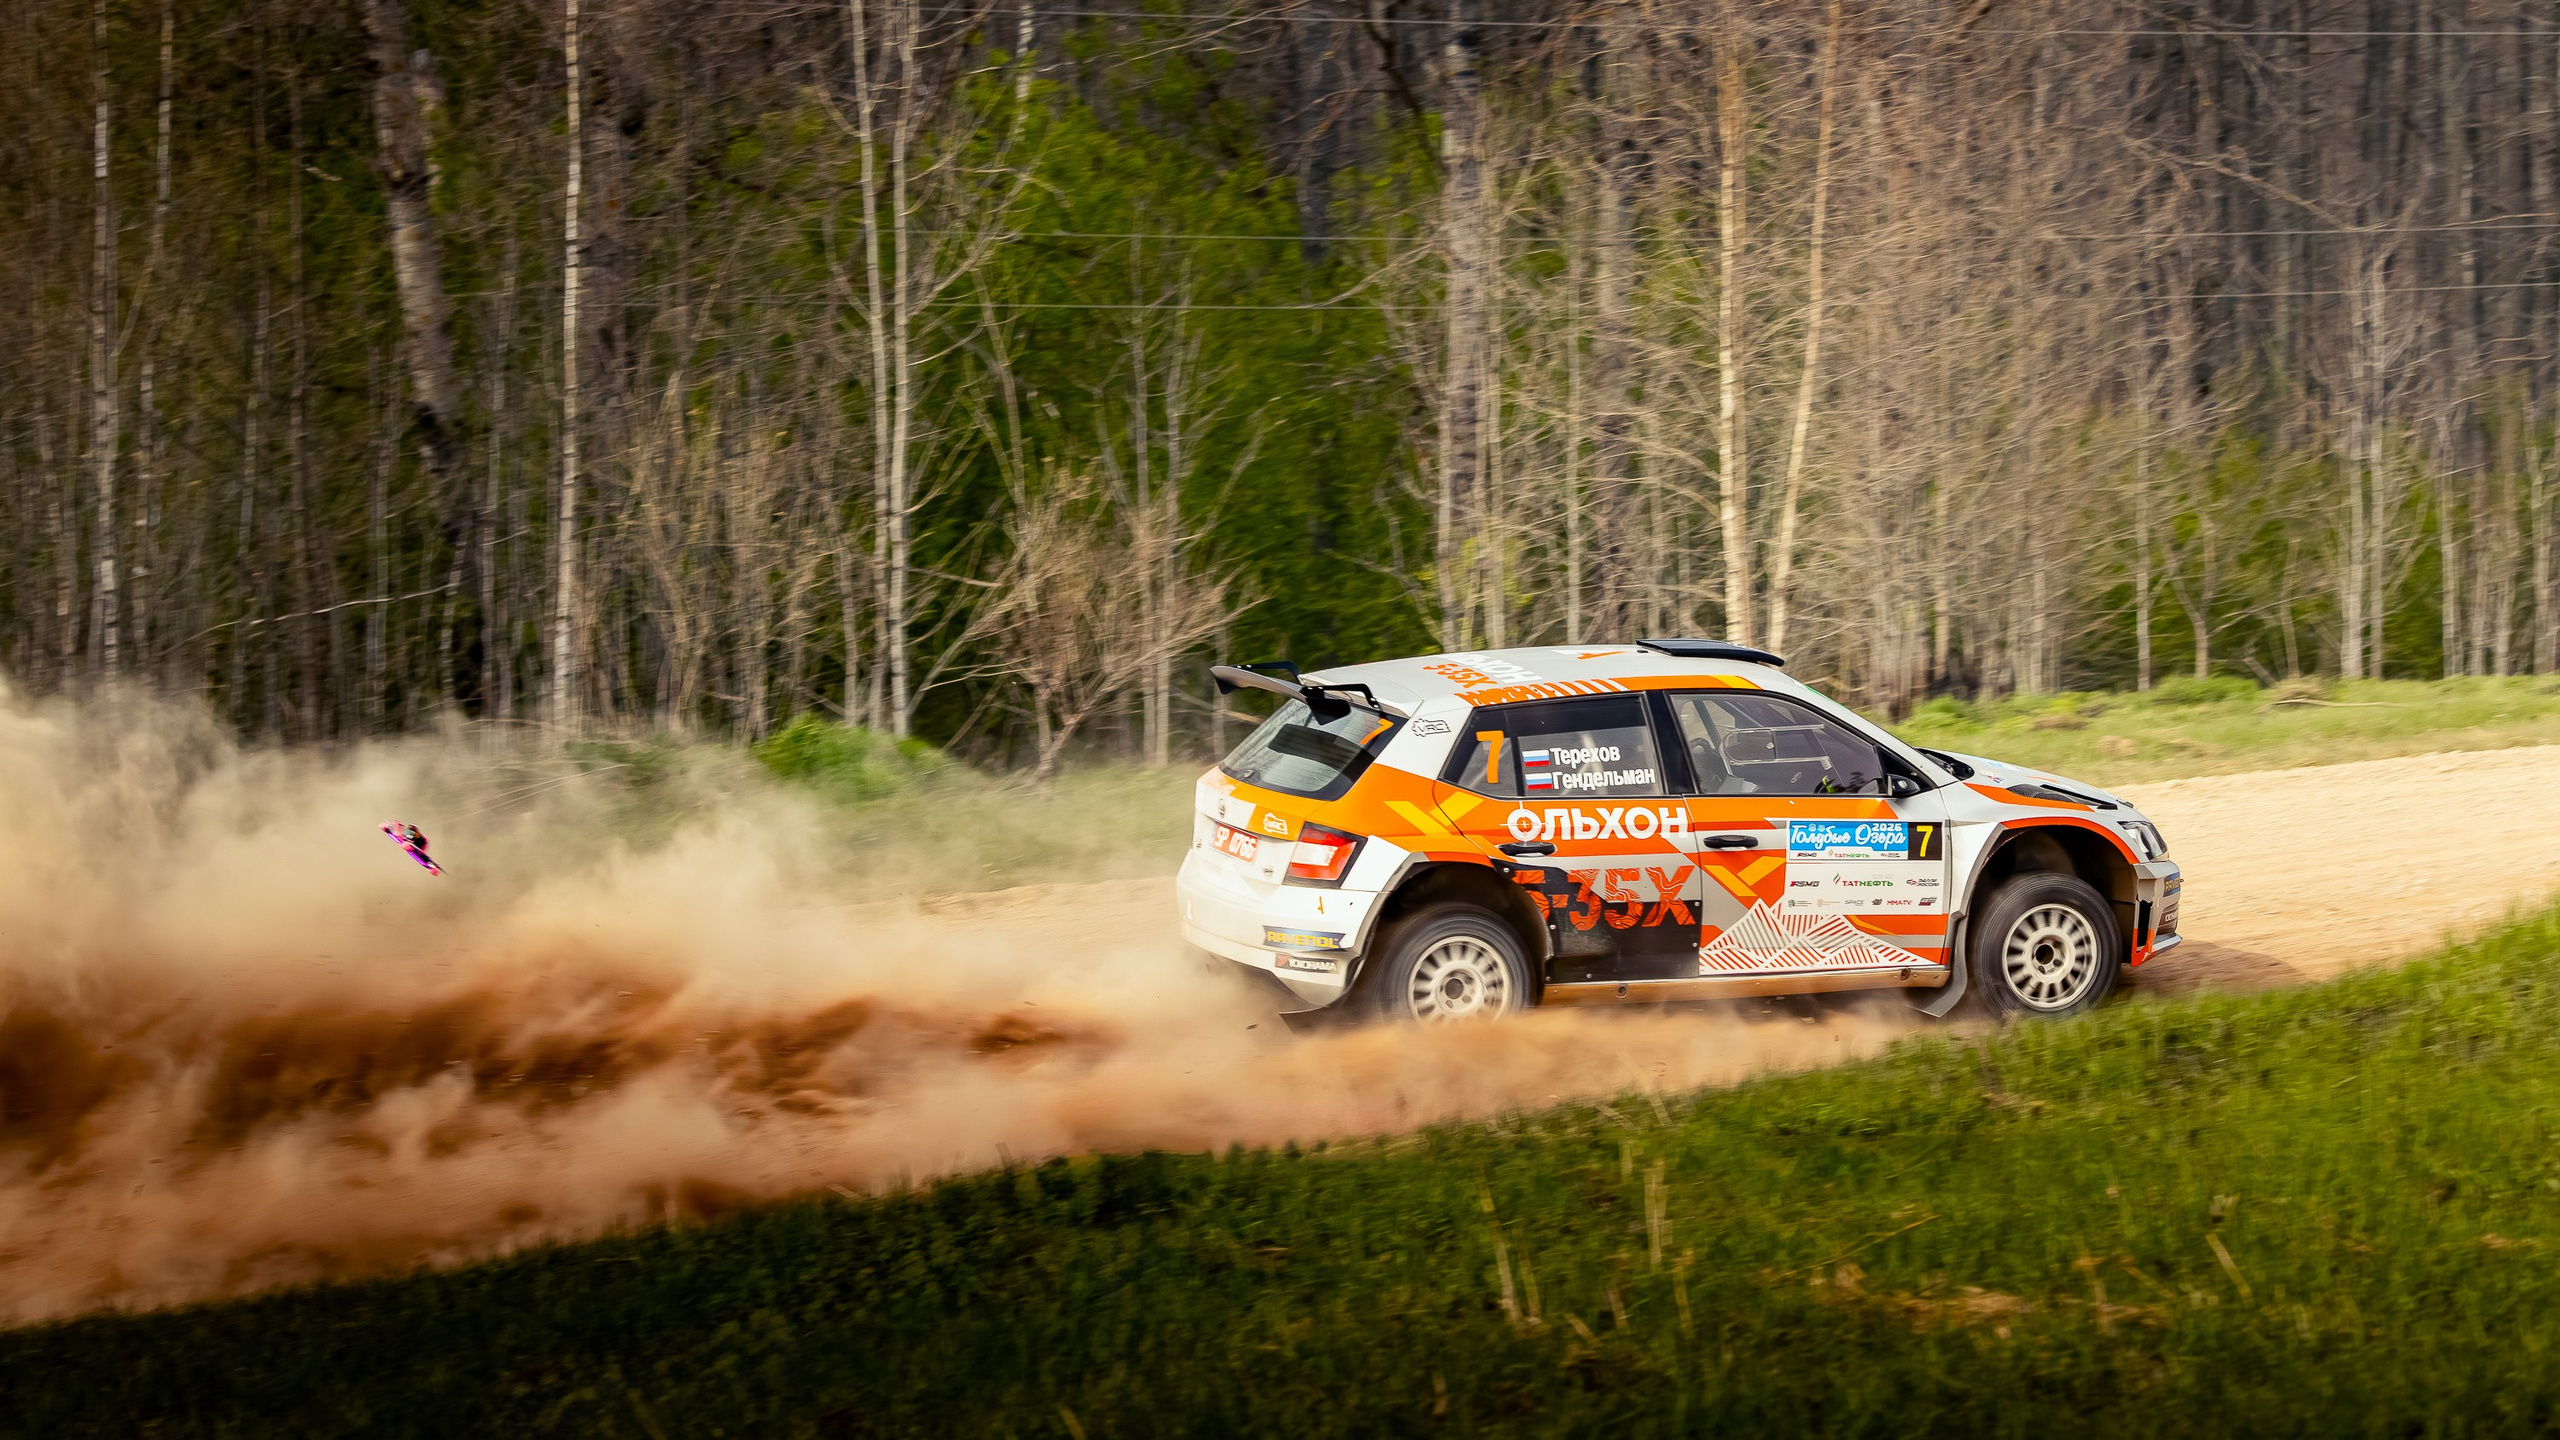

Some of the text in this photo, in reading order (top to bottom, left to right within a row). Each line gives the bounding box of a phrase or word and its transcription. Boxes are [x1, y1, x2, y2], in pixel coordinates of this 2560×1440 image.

[1360, 718, 1394, 745] 7
[1475, 730, 1505, 784] 7
[1550, 746, 1621, 769] Терехов
[1552, 768, 1656, 791] Гендельман
[1505, 806, 1689, 842] ОЛЬХОН
[1872, 823, 1902, 832] 2026
[1916, 825, 1934, 858] 7
[1266, 930, 1340, 949] RAVENOL
